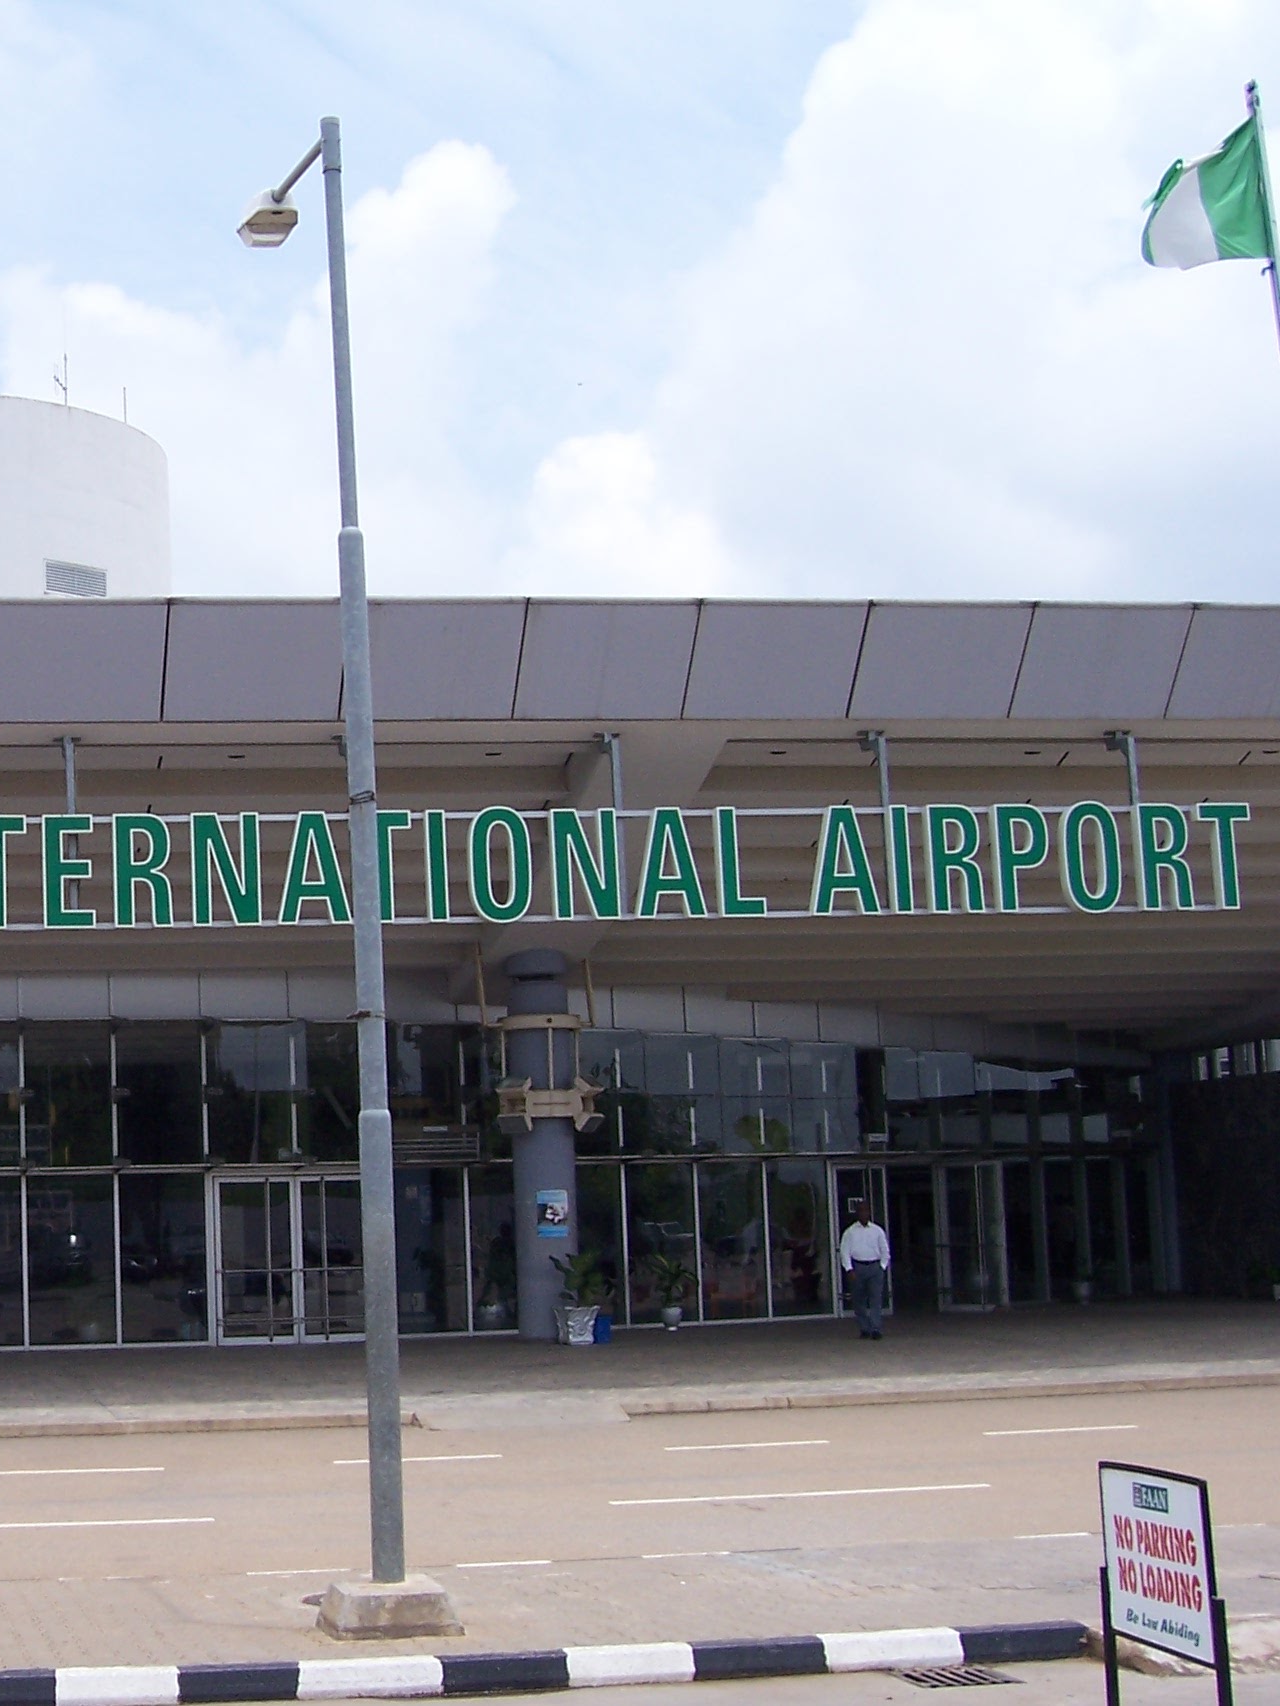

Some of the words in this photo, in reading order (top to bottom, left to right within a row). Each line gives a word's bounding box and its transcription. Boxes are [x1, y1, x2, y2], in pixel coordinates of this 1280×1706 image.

[811, 800, 1251, 915] AIRPORT
[1114, 1515, 1134, 1551] NO
[1136, 1519, 1197, 1567] PARKING
[1118, 1556, 1137, 1594] NO
[1140, 1562, 1203, 1612] LOADING
[1126, 1608, 1139, 1625] Be
[1142, 1613, 1158, 1631] Law
[1160, 1618, 1200, 1647] Abiding
